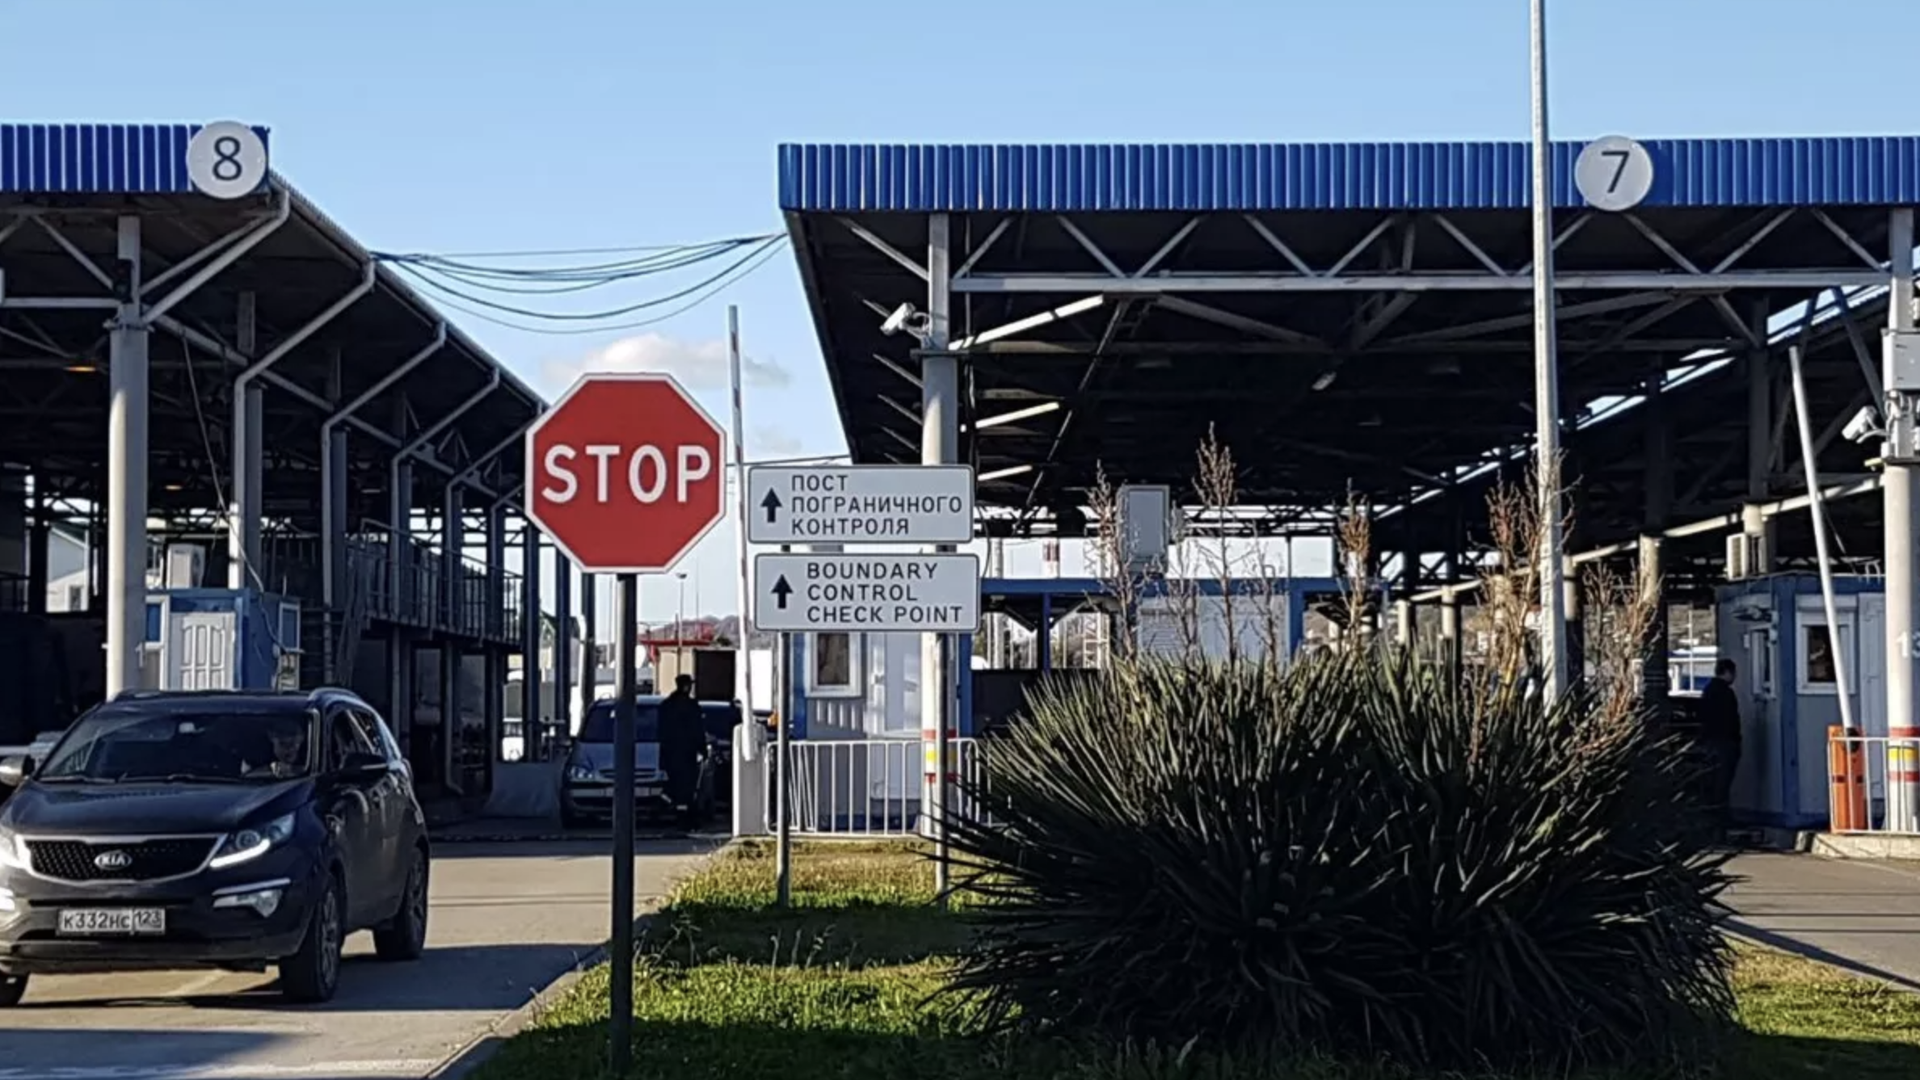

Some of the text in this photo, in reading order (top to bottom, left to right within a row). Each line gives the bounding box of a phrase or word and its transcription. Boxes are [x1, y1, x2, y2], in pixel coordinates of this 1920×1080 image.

[212, 136, 242, 181] 8
[1601, 150, 1630, 194] 7
[541, 444, 711, 504] STOP
[791, 475, 848, 492] ПОСТ
[791, 496, 962, 514] ПОГРАНИЧНОГО
[791, 518, 909, 535] КОНТРОЛЯ
[807, 562, 938, 580] BOUNDARY
[807, 584, 918, 602] CONTROL
[807, 606, 963, 624] CHECK POINT
[99, 853, 126, 867] KIA
